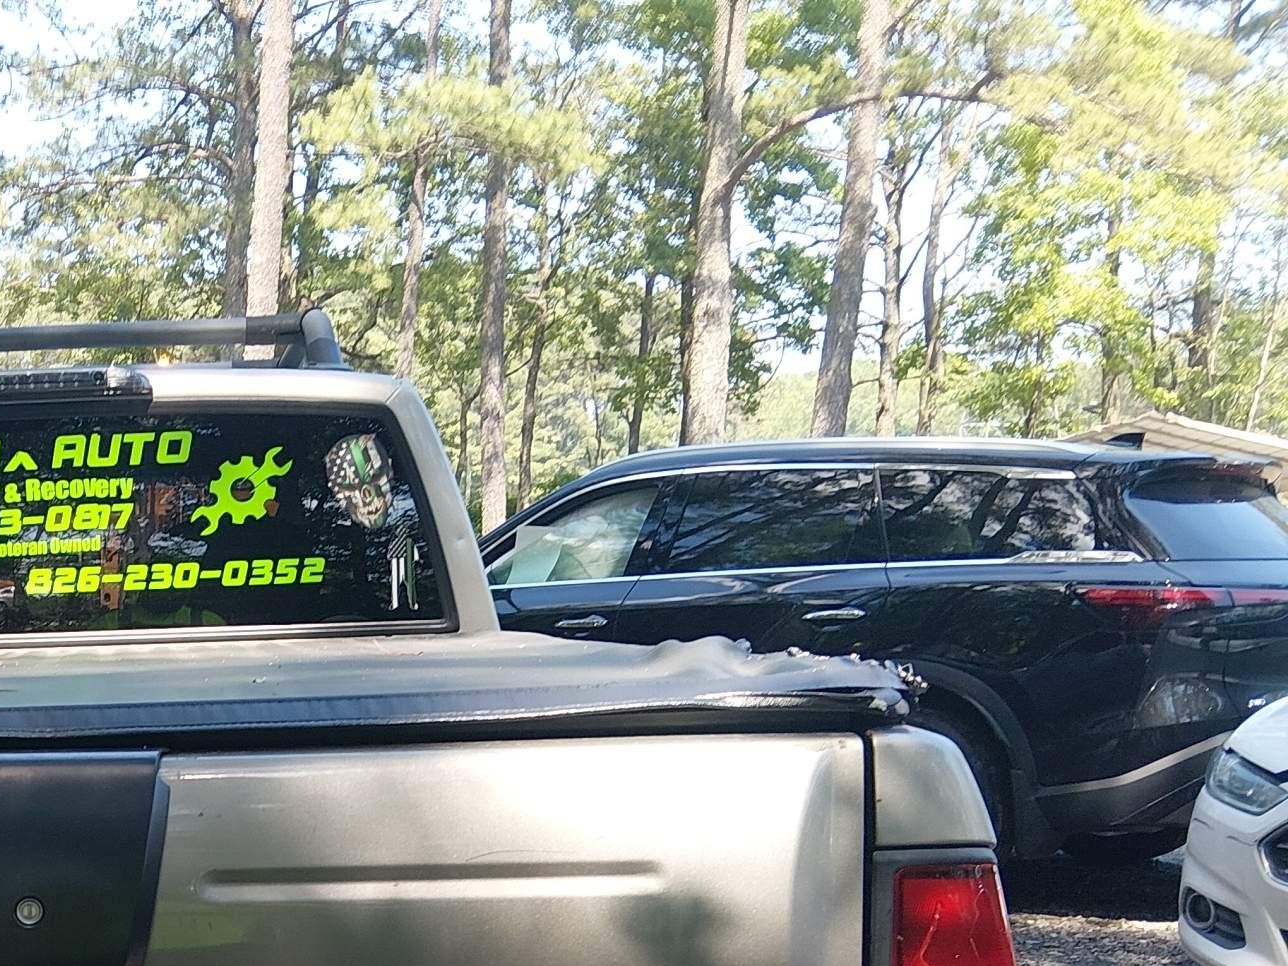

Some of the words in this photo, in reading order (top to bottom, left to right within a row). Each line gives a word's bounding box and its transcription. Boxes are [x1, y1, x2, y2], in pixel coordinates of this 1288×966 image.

[51, 430, 193, 469] AUTO
[5, 482, 21, 503] &
[25, 477, 133, 501] Recovery
[50, 535, 101, 553] Owned
[25, 557, 326, 595] 826-230-0352
